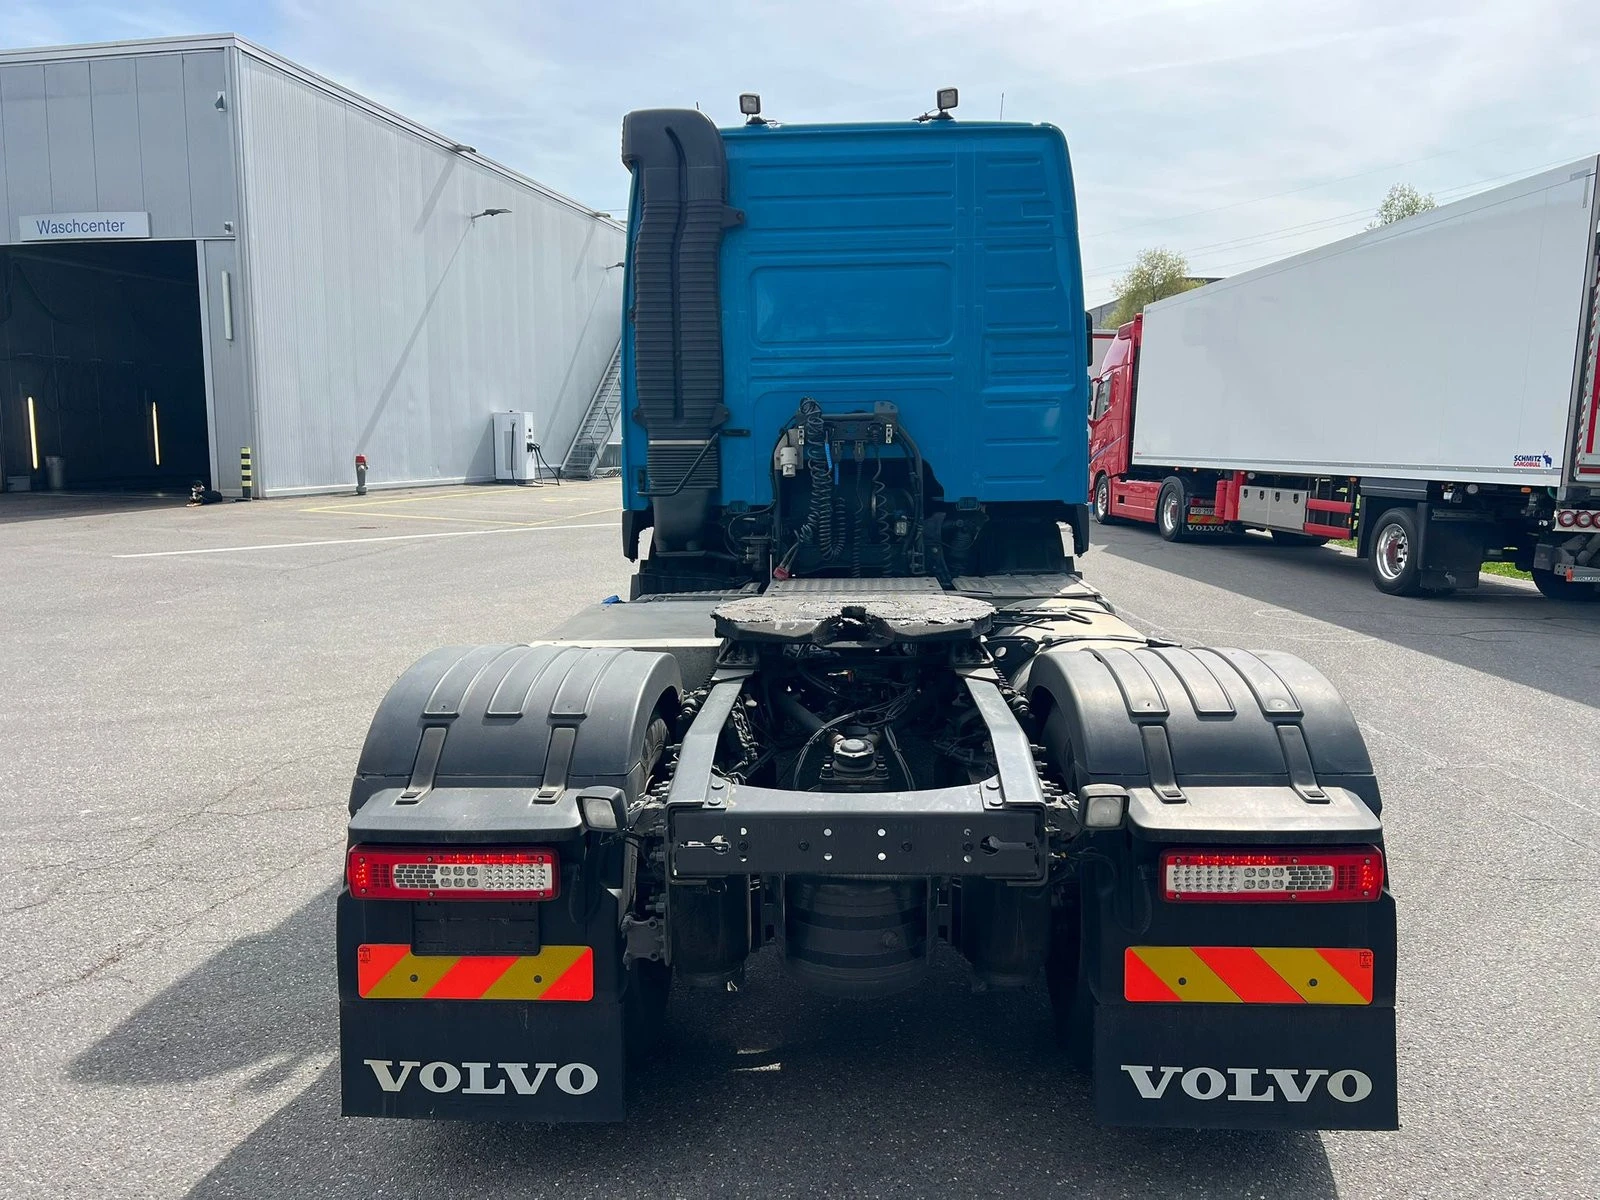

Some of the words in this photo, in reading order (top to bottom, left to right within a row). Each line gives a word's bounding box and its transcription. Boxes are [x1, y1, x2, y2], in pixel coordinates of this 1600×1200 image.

[36, 219, 126, 235] Waschcenter
[1513, 454, 1542, 462] SCHMITZ
[1187, 524, 1224, 532] VOLVO
[363, 1059, 599, 1095] VOLVO
[1120, 1064, 1373, 1103] VOLVO
